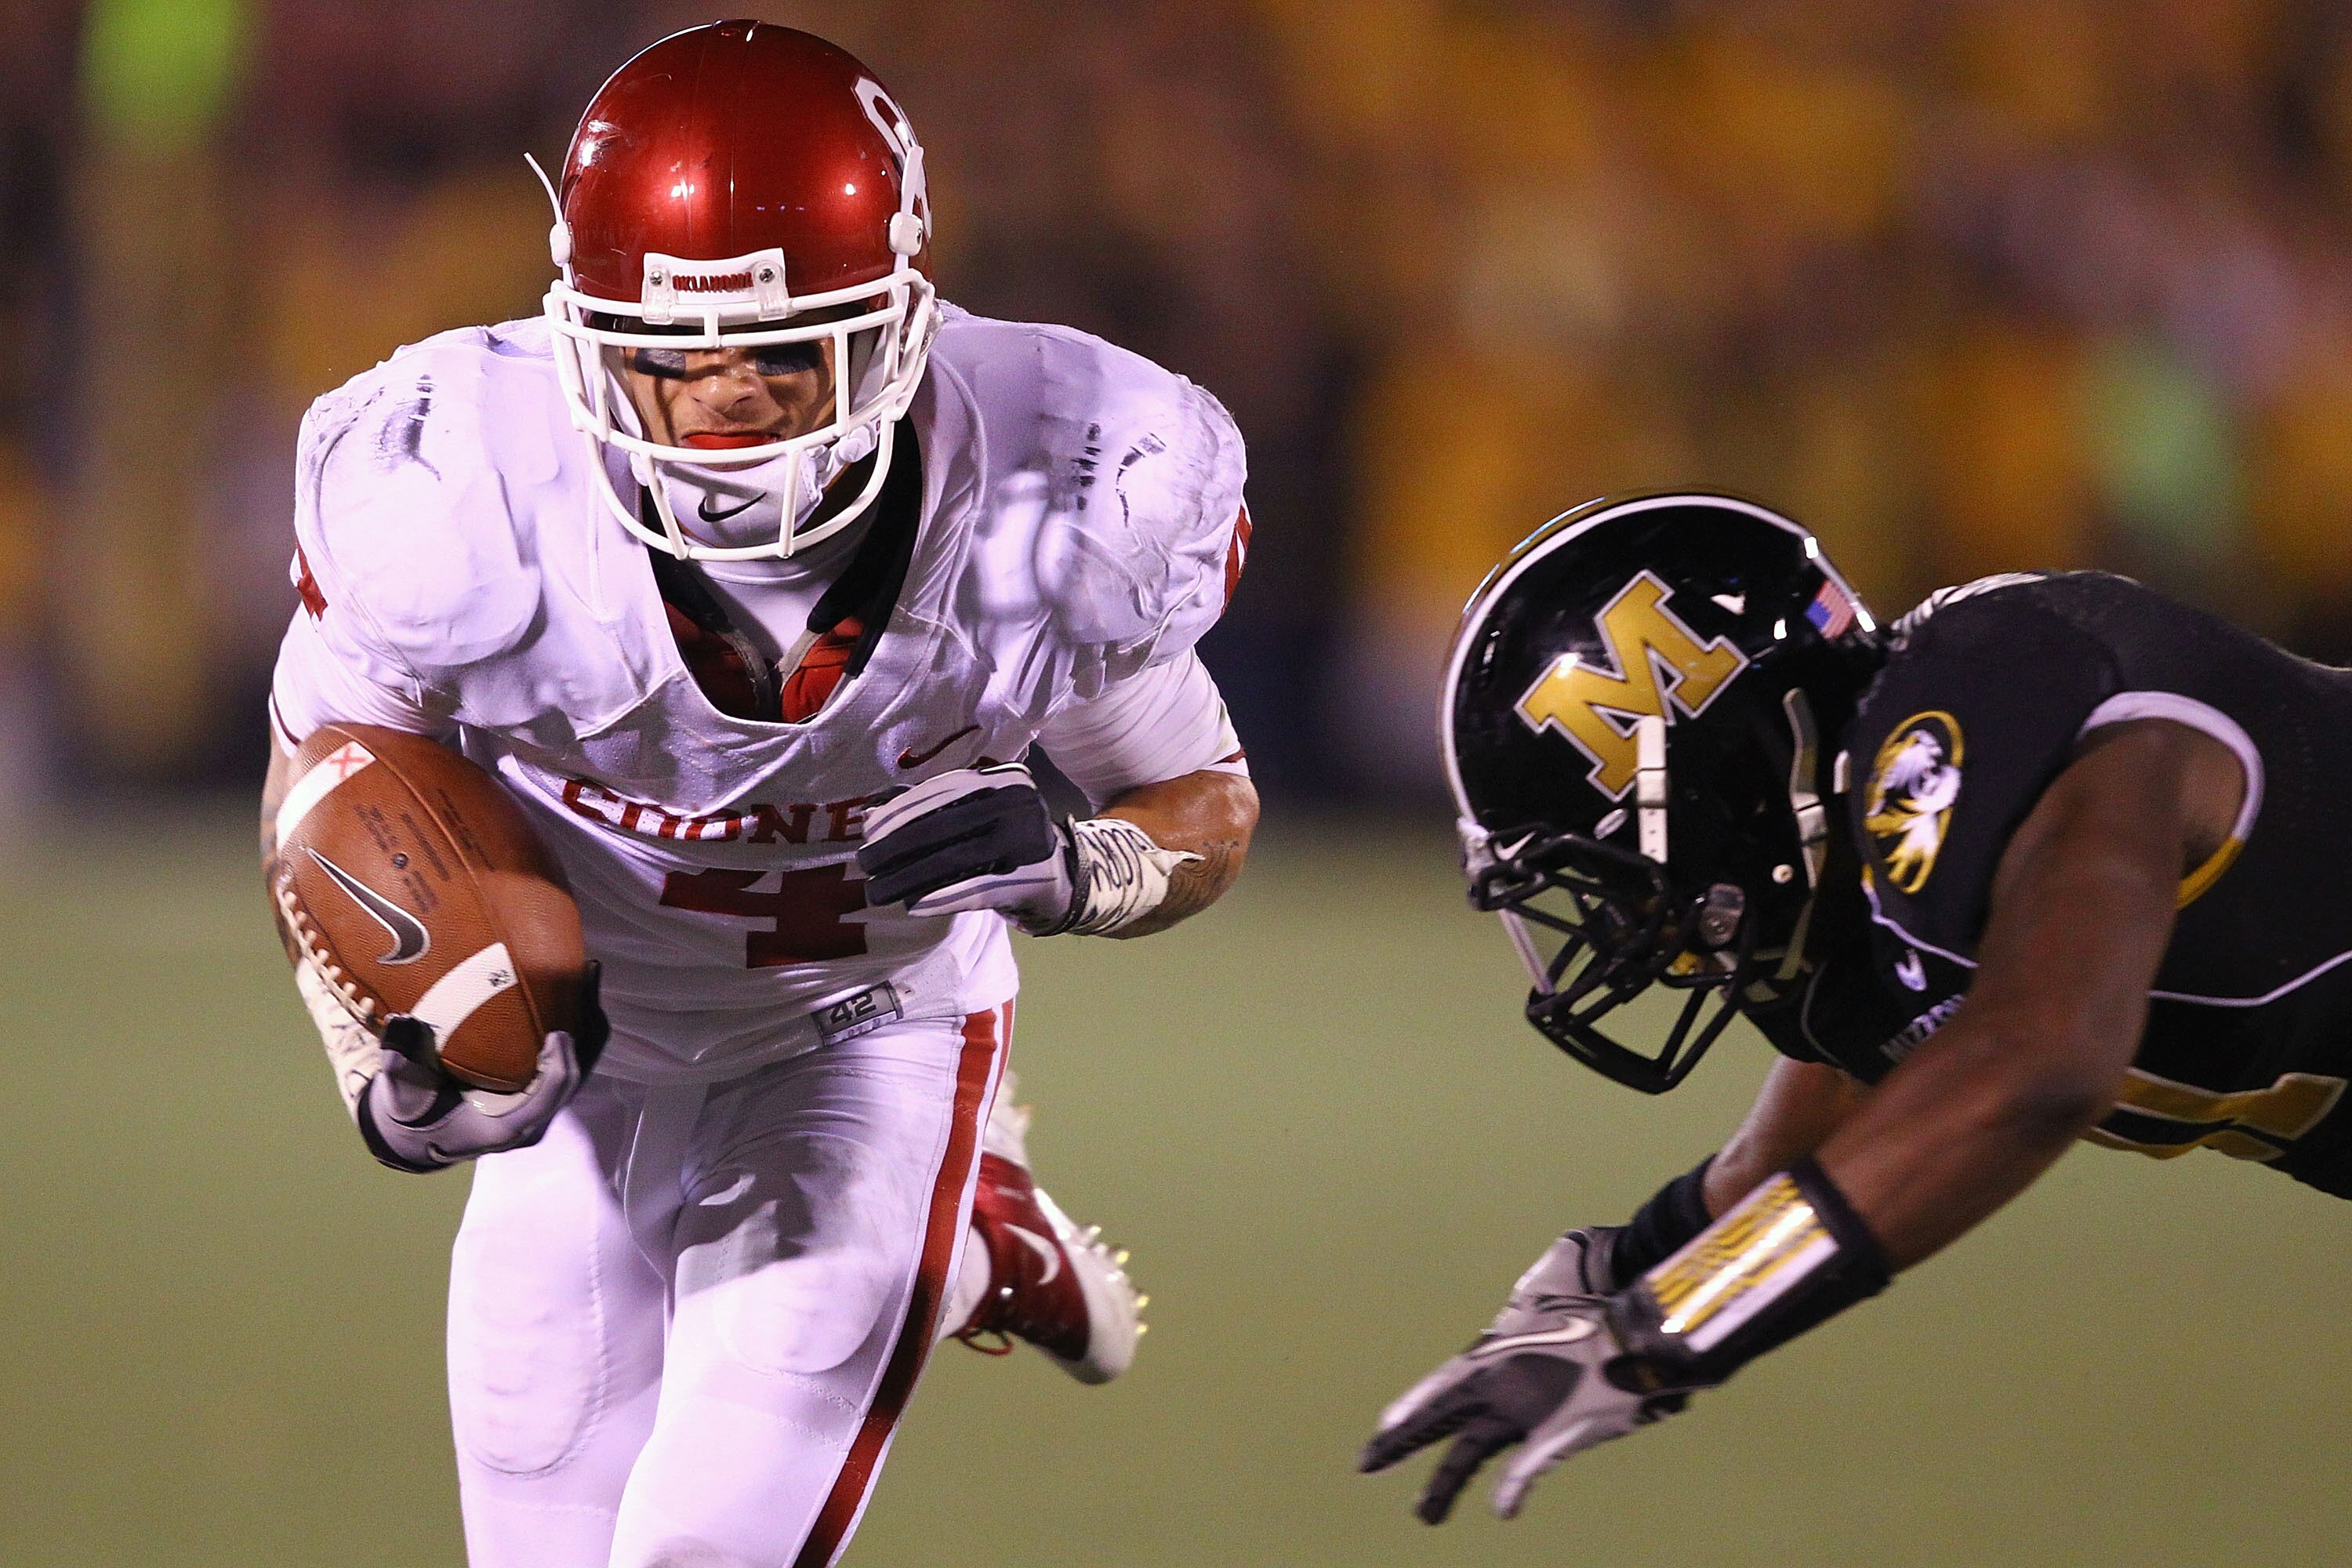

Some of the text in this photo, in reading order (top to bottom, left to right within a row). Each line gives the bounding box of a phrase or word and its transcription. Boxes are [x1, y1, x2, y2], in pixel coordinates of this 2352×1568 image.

[672, 271, 755, 293] OKLAHOMA
[1514, 569, 1751, 803] M
[659, 863, 868, 970] 4
[829, 991, 877, 1024] 42
